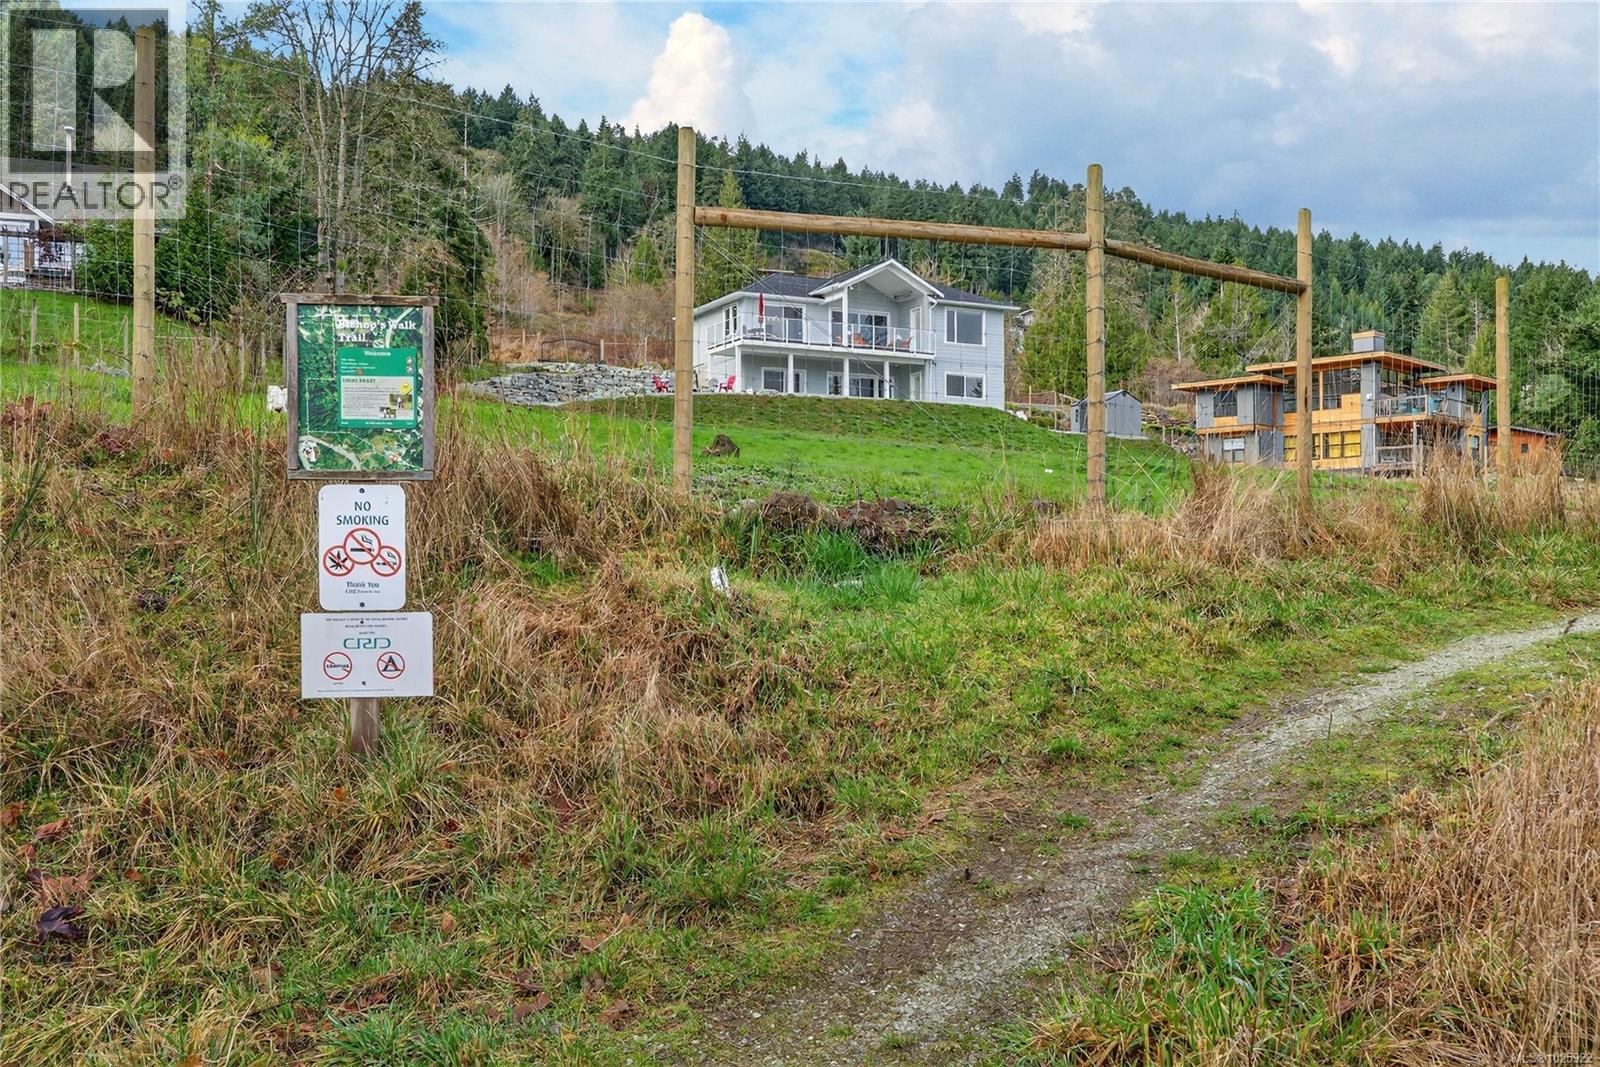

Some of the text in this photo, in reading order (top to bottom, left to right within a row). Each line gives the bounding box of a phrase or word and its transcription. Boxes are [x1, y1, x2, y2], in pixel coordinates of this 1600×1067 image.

[336, 318, 416, 331] Bishop's Walk
[337, 333, 366, 342] Trail
[354, 501, 371, 512] NO
[336, 515, 389, 526] SMOKING
[343, 637, 391, 649] CRD
